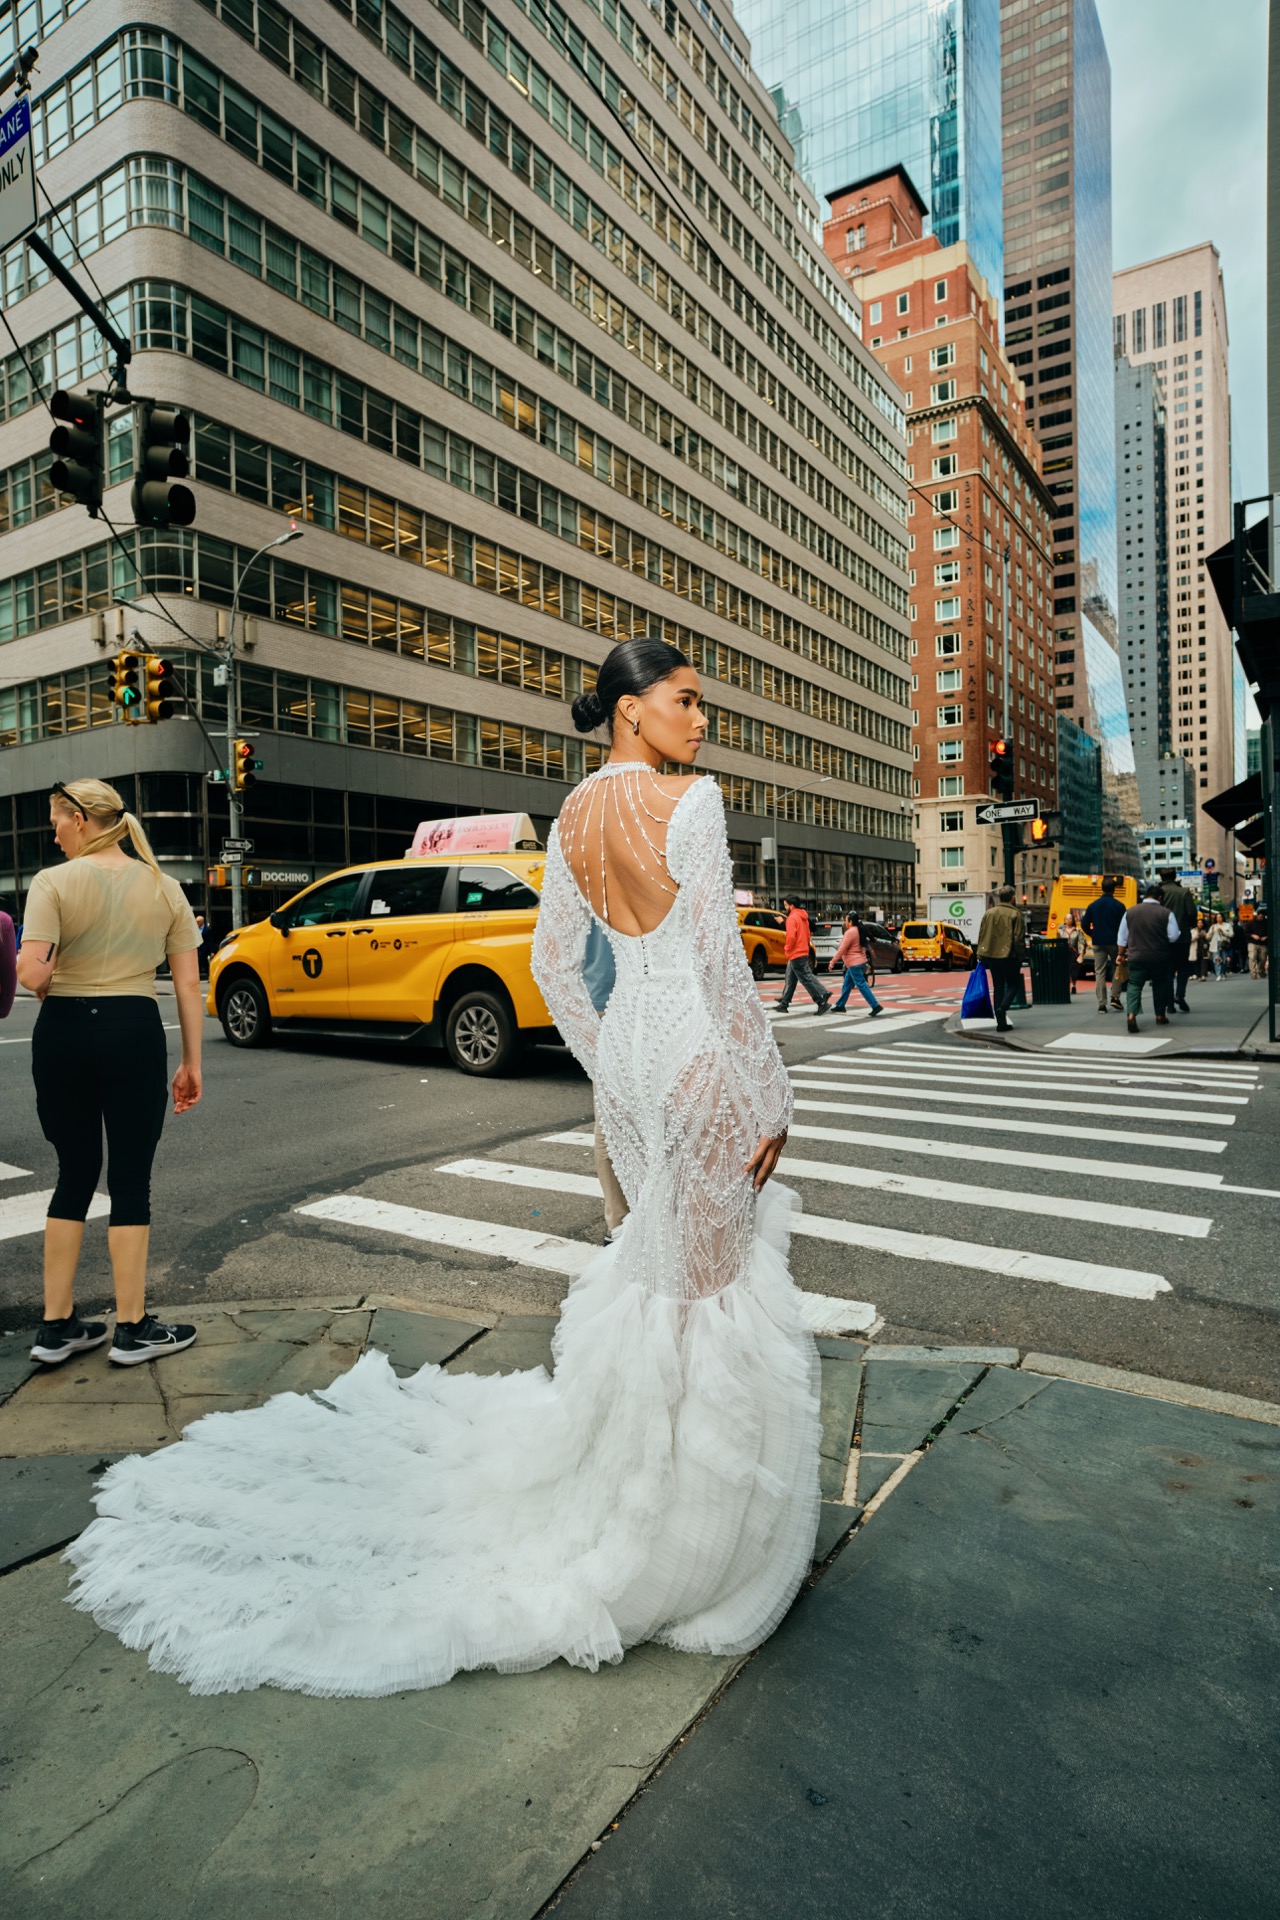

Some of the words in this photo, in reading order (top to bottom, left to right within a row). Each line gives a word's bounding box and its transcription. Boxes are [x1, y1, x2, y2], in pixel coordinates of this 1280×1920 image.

[967, 639, 977, 720] PLACE
[985, 809, 1002, 818] ONE
[1013, 806, 1031, 815] WAY
